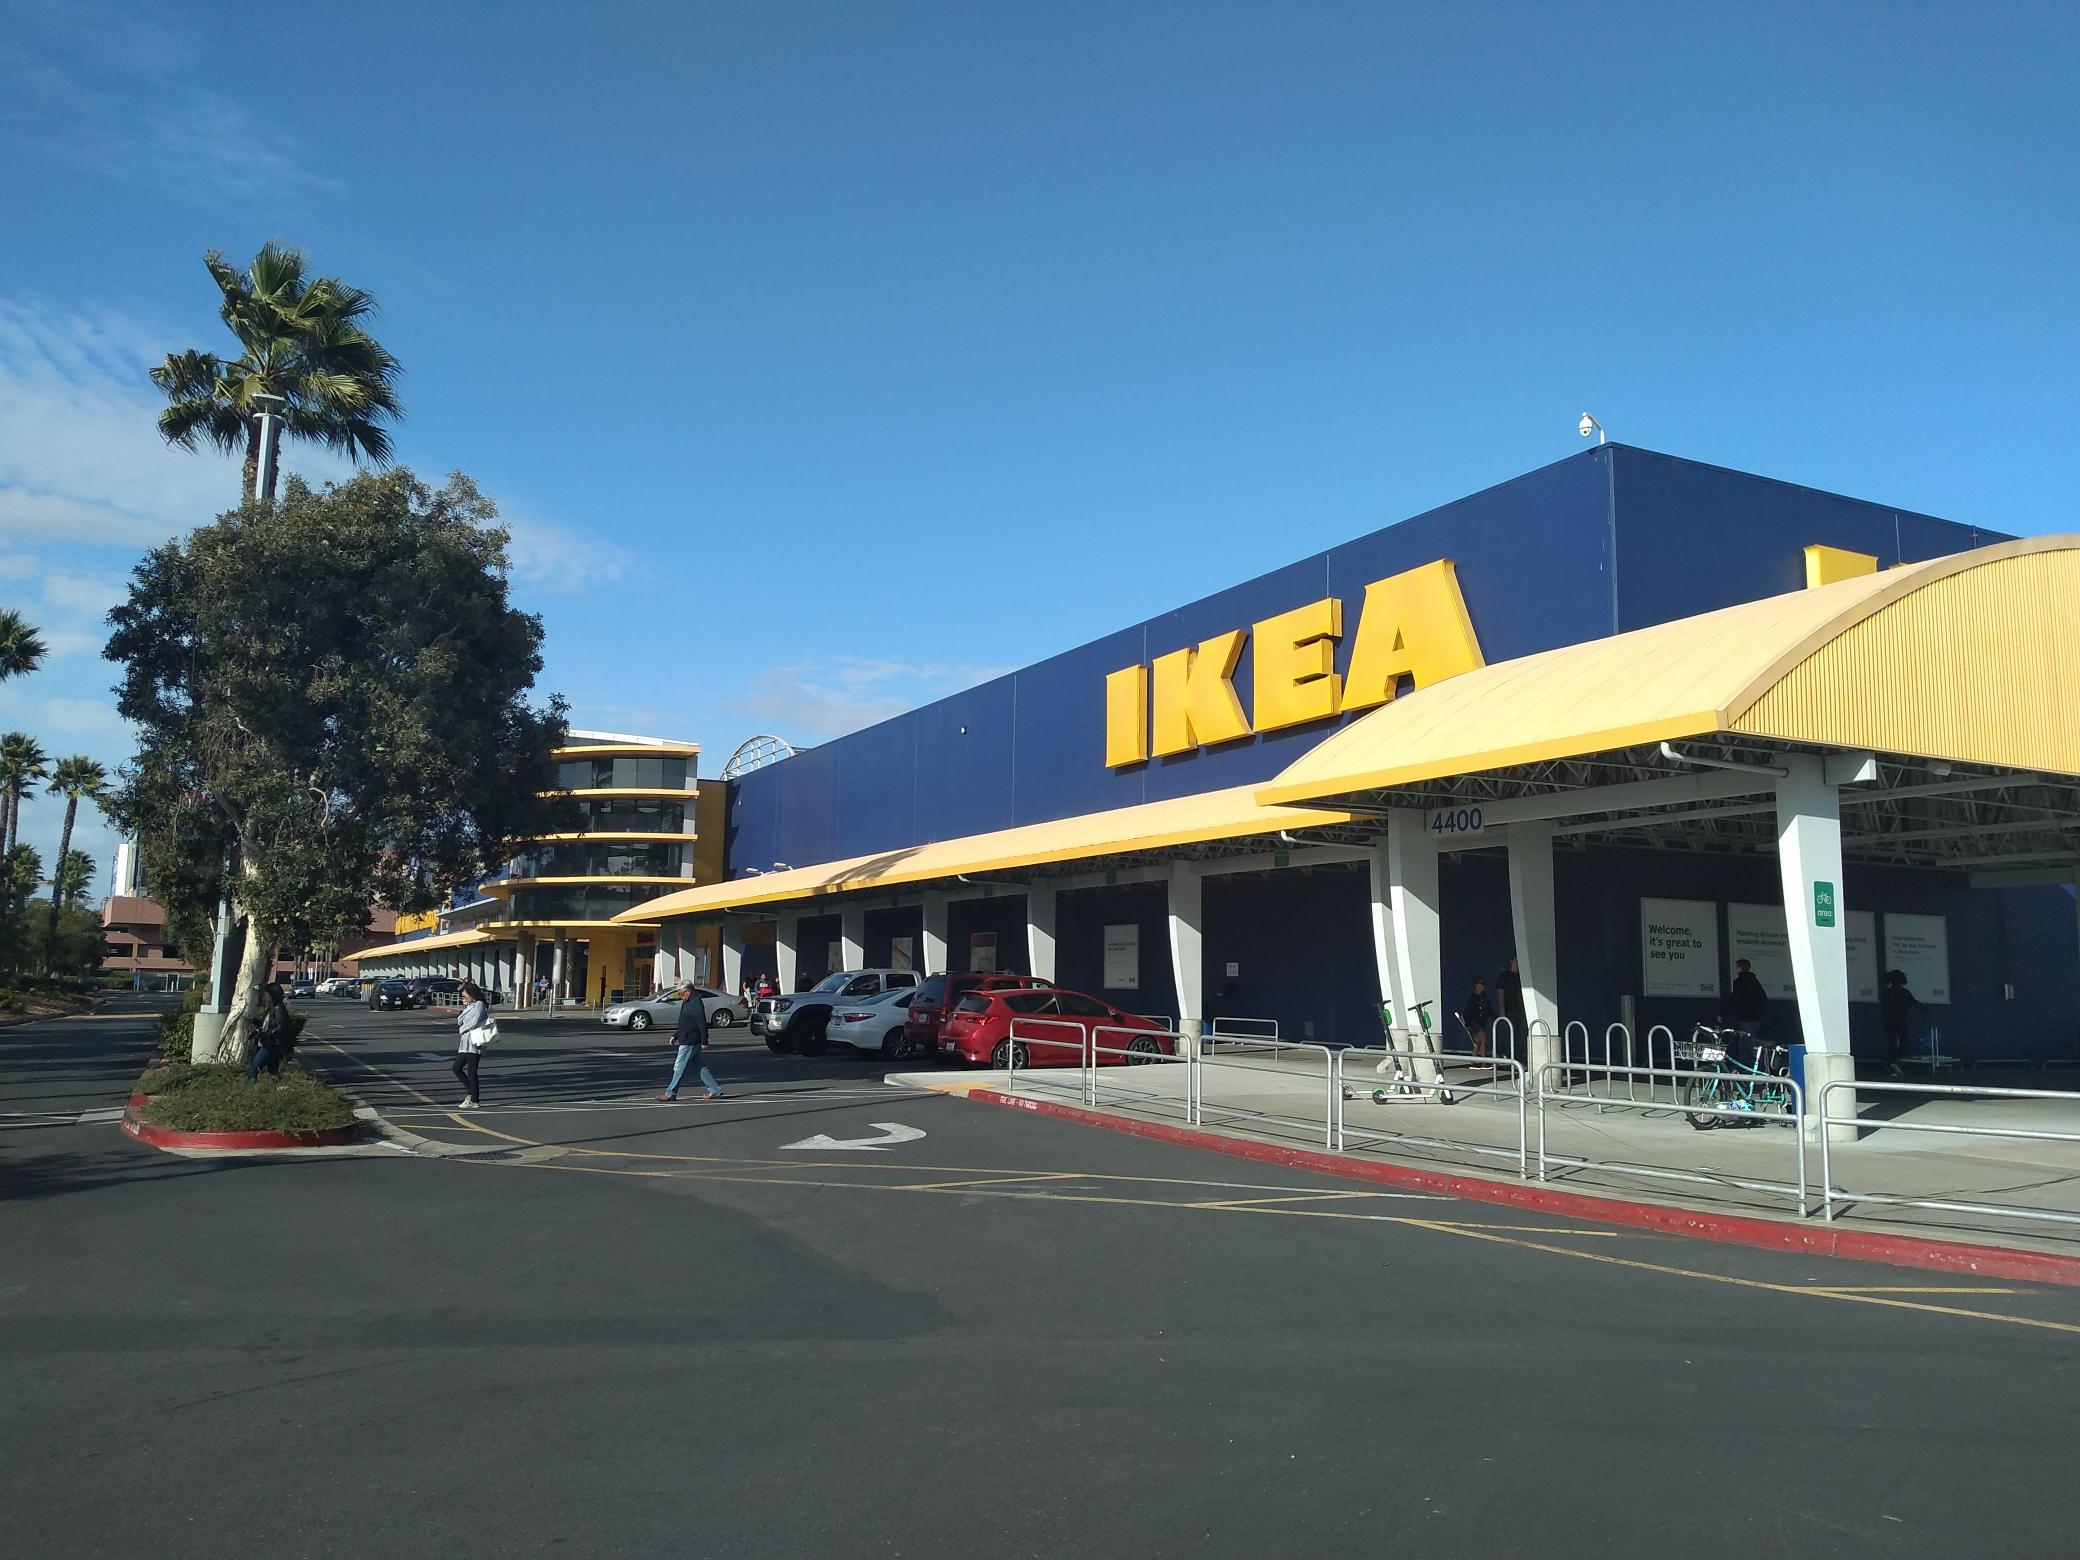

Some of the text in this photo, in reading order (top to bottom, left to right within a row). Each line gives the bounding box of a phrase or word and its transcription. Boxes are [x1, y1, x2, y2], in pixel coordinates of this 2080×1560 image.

[1106, 558, 1487, 767] IKEA
[1431, 807, 1483, 834] 4400
[1648, 924, 1692, 936] Welcome,
[1666, 939, 1691, 949] great
[1692, 939, 1702, 948] to
[1650, 950, 1685, 961] see you
